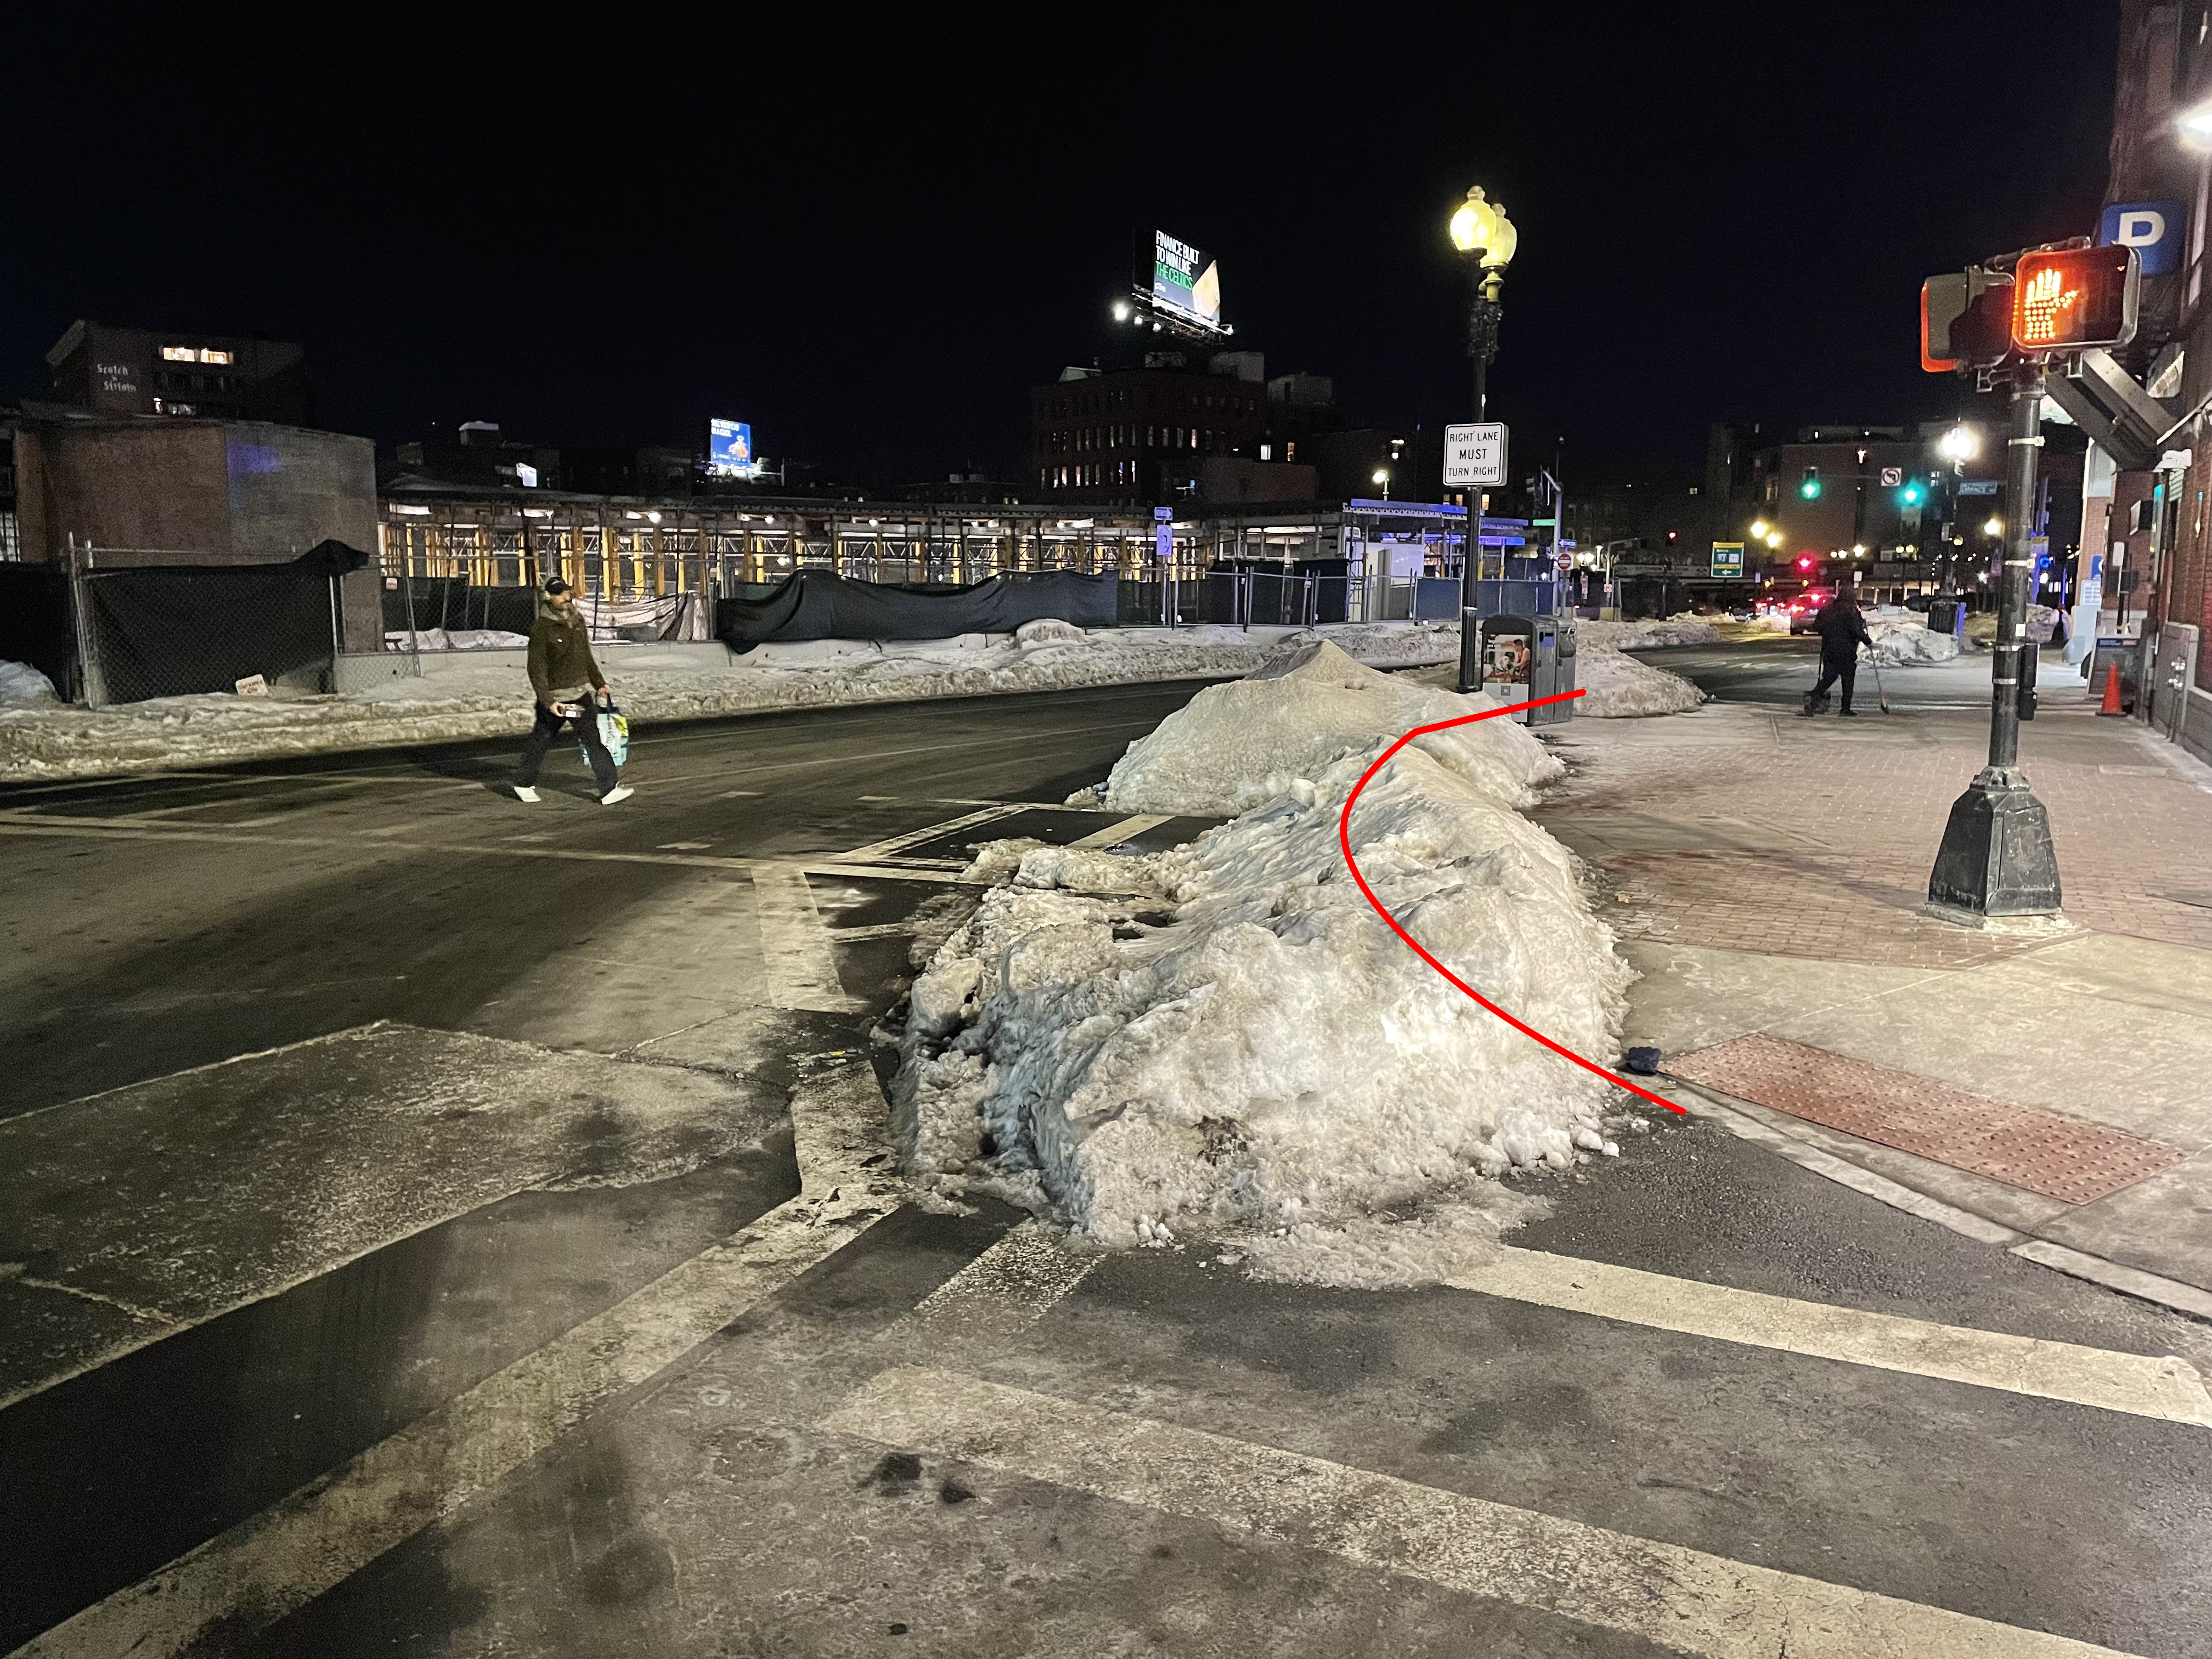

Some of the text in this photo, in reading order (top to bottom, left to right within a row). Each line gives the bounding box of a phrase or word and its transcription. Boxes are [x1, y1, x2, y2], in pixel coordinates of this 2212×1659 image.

[1156, 230, 1200, 265] FINANCE BUILT
[1156, 245, 1192, 276] TO WIN LIKE
[1155, 261, 1169, 280] THE
[1169, 268, 1193, 291] CELTICS
[1449, 431, 1498, 442] RIGHT LANE
[1459, 448, 1487, 460] MUST
[1448, 466, 1497, 476] TURN RIGHT
